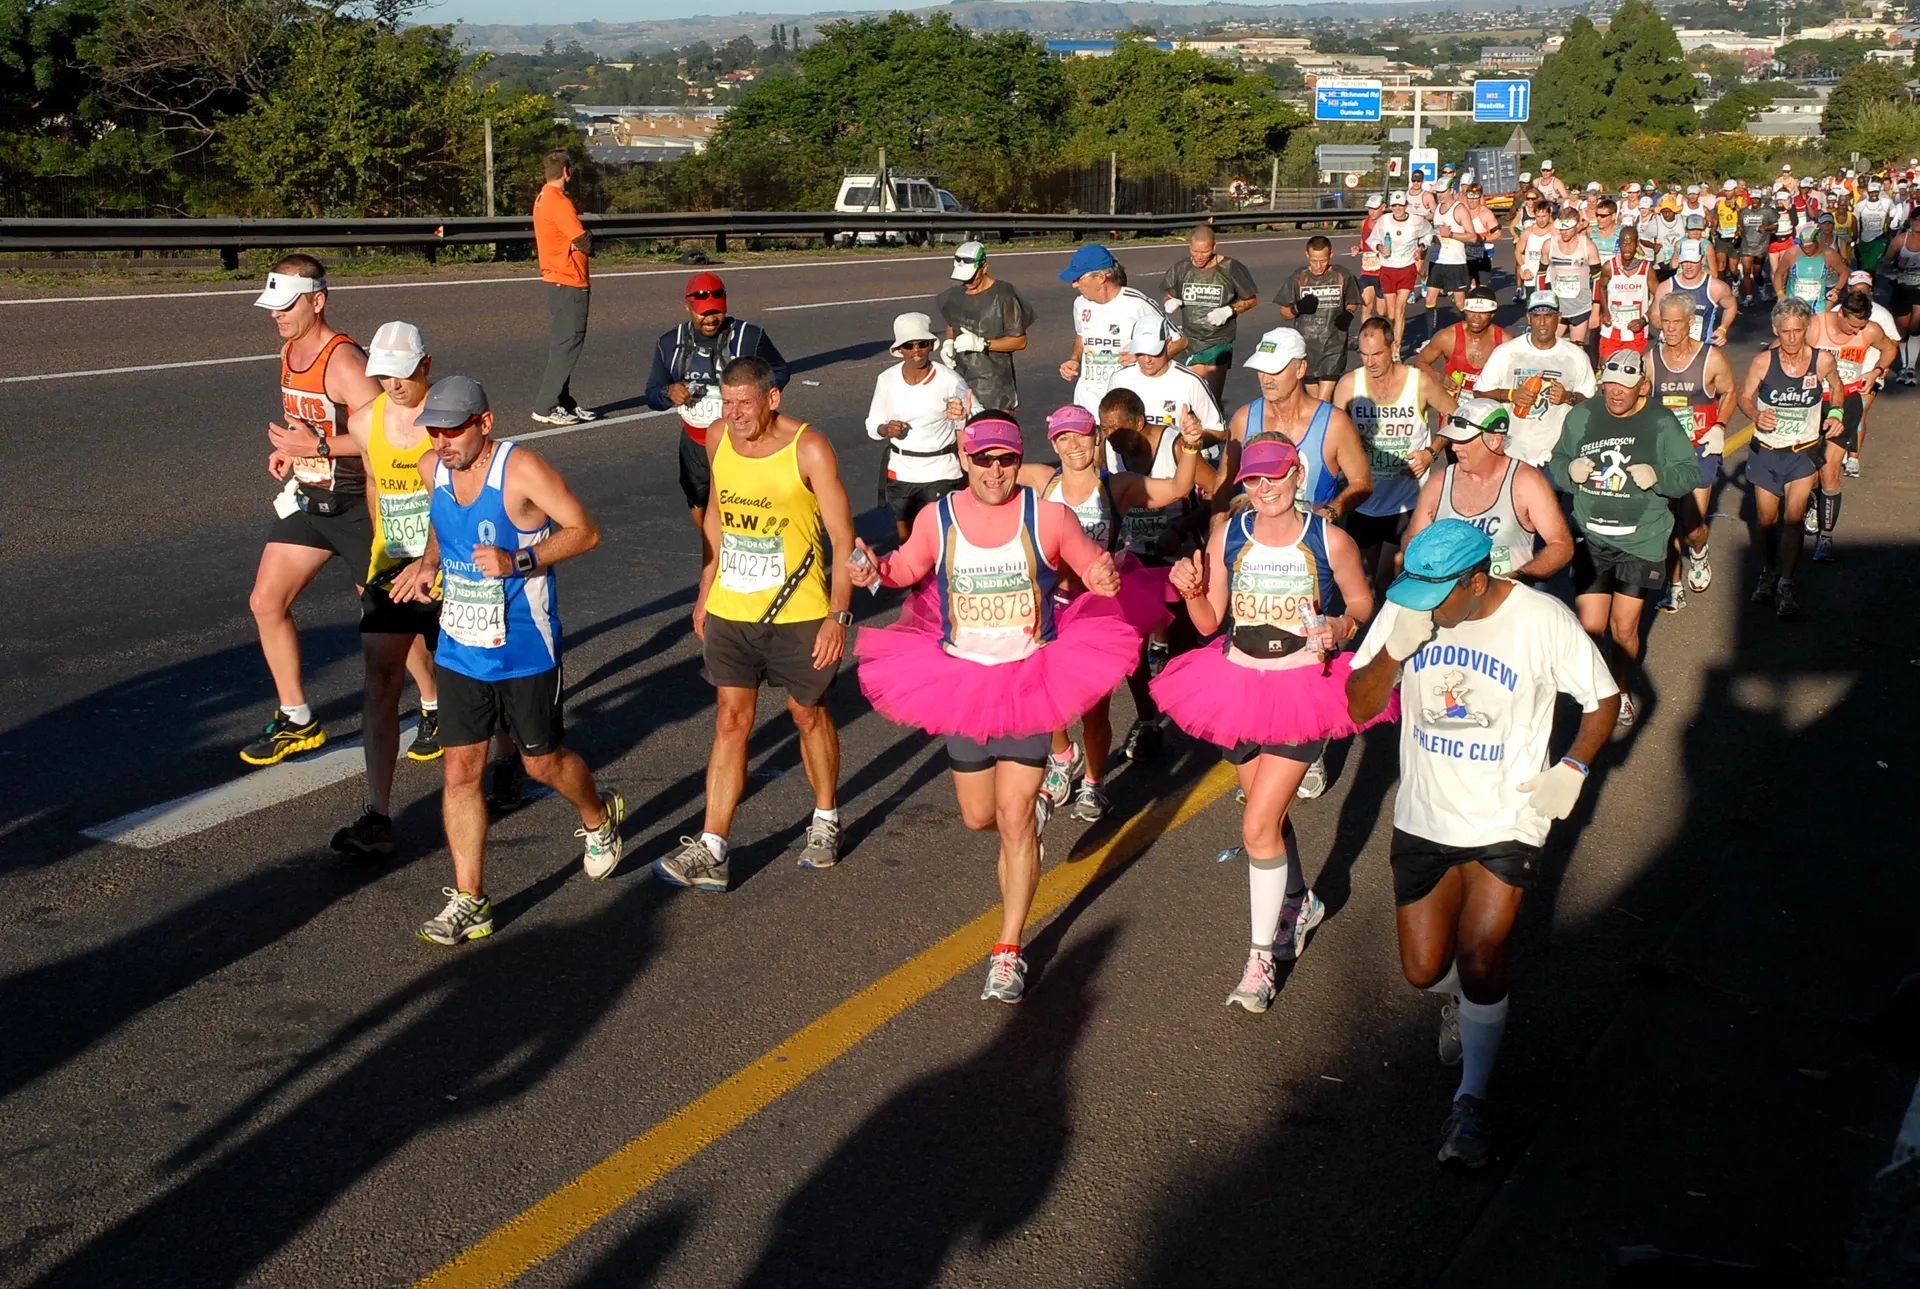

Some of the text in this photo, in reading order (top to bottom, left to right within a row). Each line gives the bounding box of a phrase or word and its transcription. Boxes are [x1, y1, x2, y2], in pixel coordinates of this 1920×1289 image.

[1191, 284, 1221, 296] bonitas
[1081, 309, 1092, 322] 50
[1084, 338, 1121, 347] JEPPE
[1661, 382, 1694, 392] SCAW
[300, 396, 326, 420] STS
[1356, 406, 1415, 418] ELLISRAS
[1581, 437, 1635, 453] STELLENBOSCH
[719, 489, 772, 509] Edenvale
[389, 500, 429, 512] NEDBANK
[954, 561, 1027, 574] Sunninghill
[1241, 561, 1306, 574] Sunninghill
[975, 576, 1024, 589] NEDBANK
[1257, 579, 1304, 589] NEDBANK
[456, 588, 496, 598] NEDBANK
[957, 592, 1032, 621] C58878
[1413, 645, 1518, 692] WOODVIEW
[1413, 724, 1505, 761] ATHLETIC CLUB
